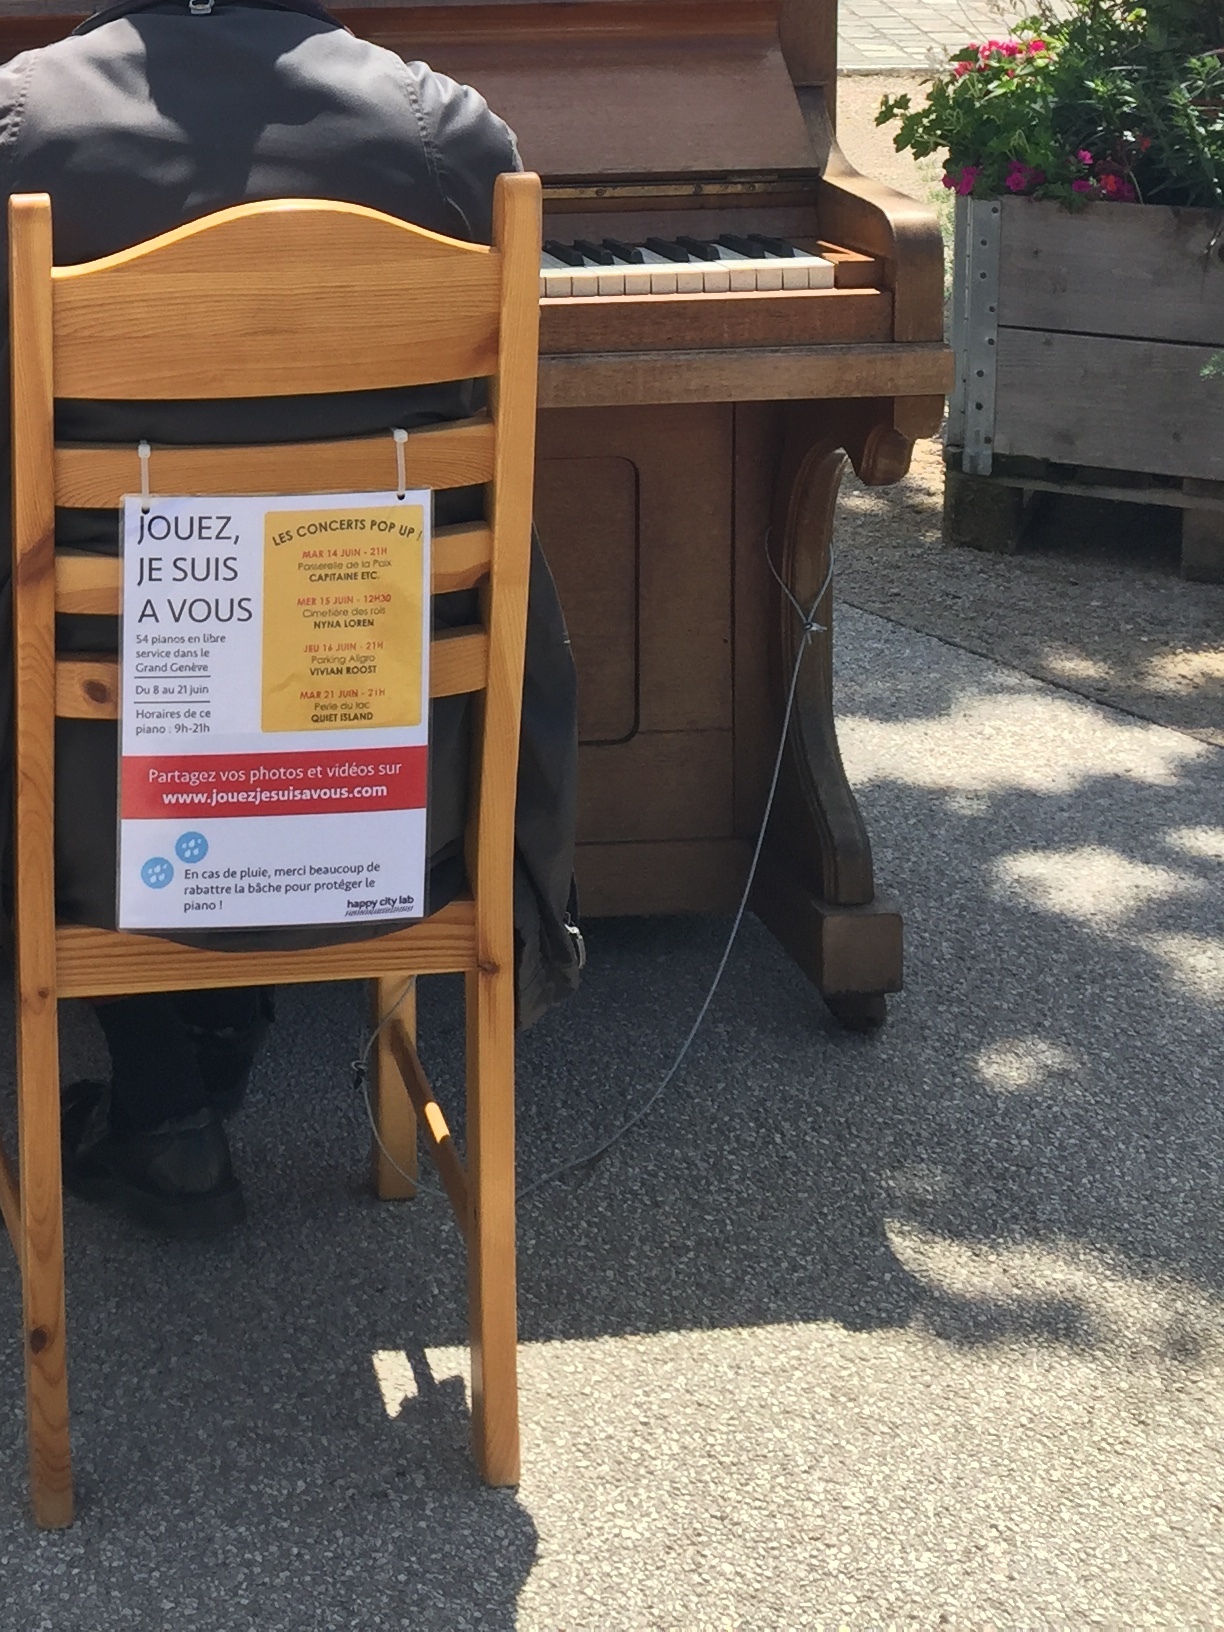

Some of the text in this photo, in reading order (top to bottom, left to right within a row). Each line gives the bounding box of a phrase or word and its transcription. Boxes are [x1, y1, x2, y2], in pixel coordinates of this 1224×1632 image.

[137, 515, 239, 545] JOUEZ,
[272, 530, 293, 546] LES
[297, 519, 366, 537] CONCERTS
[370, 520, 395, 533] POP
[399, 524, 415, 538] UP
[302, 550, 324, 559] MAR
[327, 549, 337, 557] 14
[340, 548, 360, 557] JUIN
[370, 547, 387, 556] 21H
[346, 560, 359, 569] de
[362, 560, 370, 568] la
[373, 559, 392, 568] Paix
[137, 557, 238, 587] JE SUIS
[309, 571, 380, 582] CAPITAINE ETC.
[297, 597, 316, 606] MER
[320, 597, 330, 605] 15
[333, 596, 353, 605] JUIN
[364, 594, 391, 603] 12H30
[138, 598, 252, 623] A VOUS
[352, 607, 368, 616] des
[370, 606, 385, 615] rois
[314, 619, 374, 629] NYNA LOREN
[136, 634, 226, 645] 54 pianos en libre
[304, 644, 319, 653] JEU
[323, 644, 333, 652] 16
[336, 643, 356, 651] JUIN
[366, 641, 383, 650] 21H
[136, 648, 210, 658] service dans le
[312, 655, 346, 665] Parking
[136, 663, 208, 672] Grand Genève
[310, 665, 377, 676] VIVIAN ROOST
[136, 685, 209, 696] Du 8 au 21 juin
[300, 691, 321, 700] MAR
[324, 690, 334, 699] 21
[338, 689, 358, 698] JUIN
[341, 702, 353, 710] du
[355, 701, 370, 710] lac
[136, 709, 211, 719] Horaires de ce
[311, 712, 373, 723] QUIET ISLAND
[136, 724, 166, 736] piano
[175, 723, 210, 733] 9h-21h
[148, 762, 402, 787] Partagez vos photos et vidéos sur
[163, 785, 387, 806] www.jouezjesuisavous.com
[184, 862, 380, 881] En cas de pluie, merci beaucoup de
[184, 878, 375, 895] rabattre la bâche pour protéger le
[184, 900, 216, 913] piano
[347, 895, 414, 909] happy city lab
